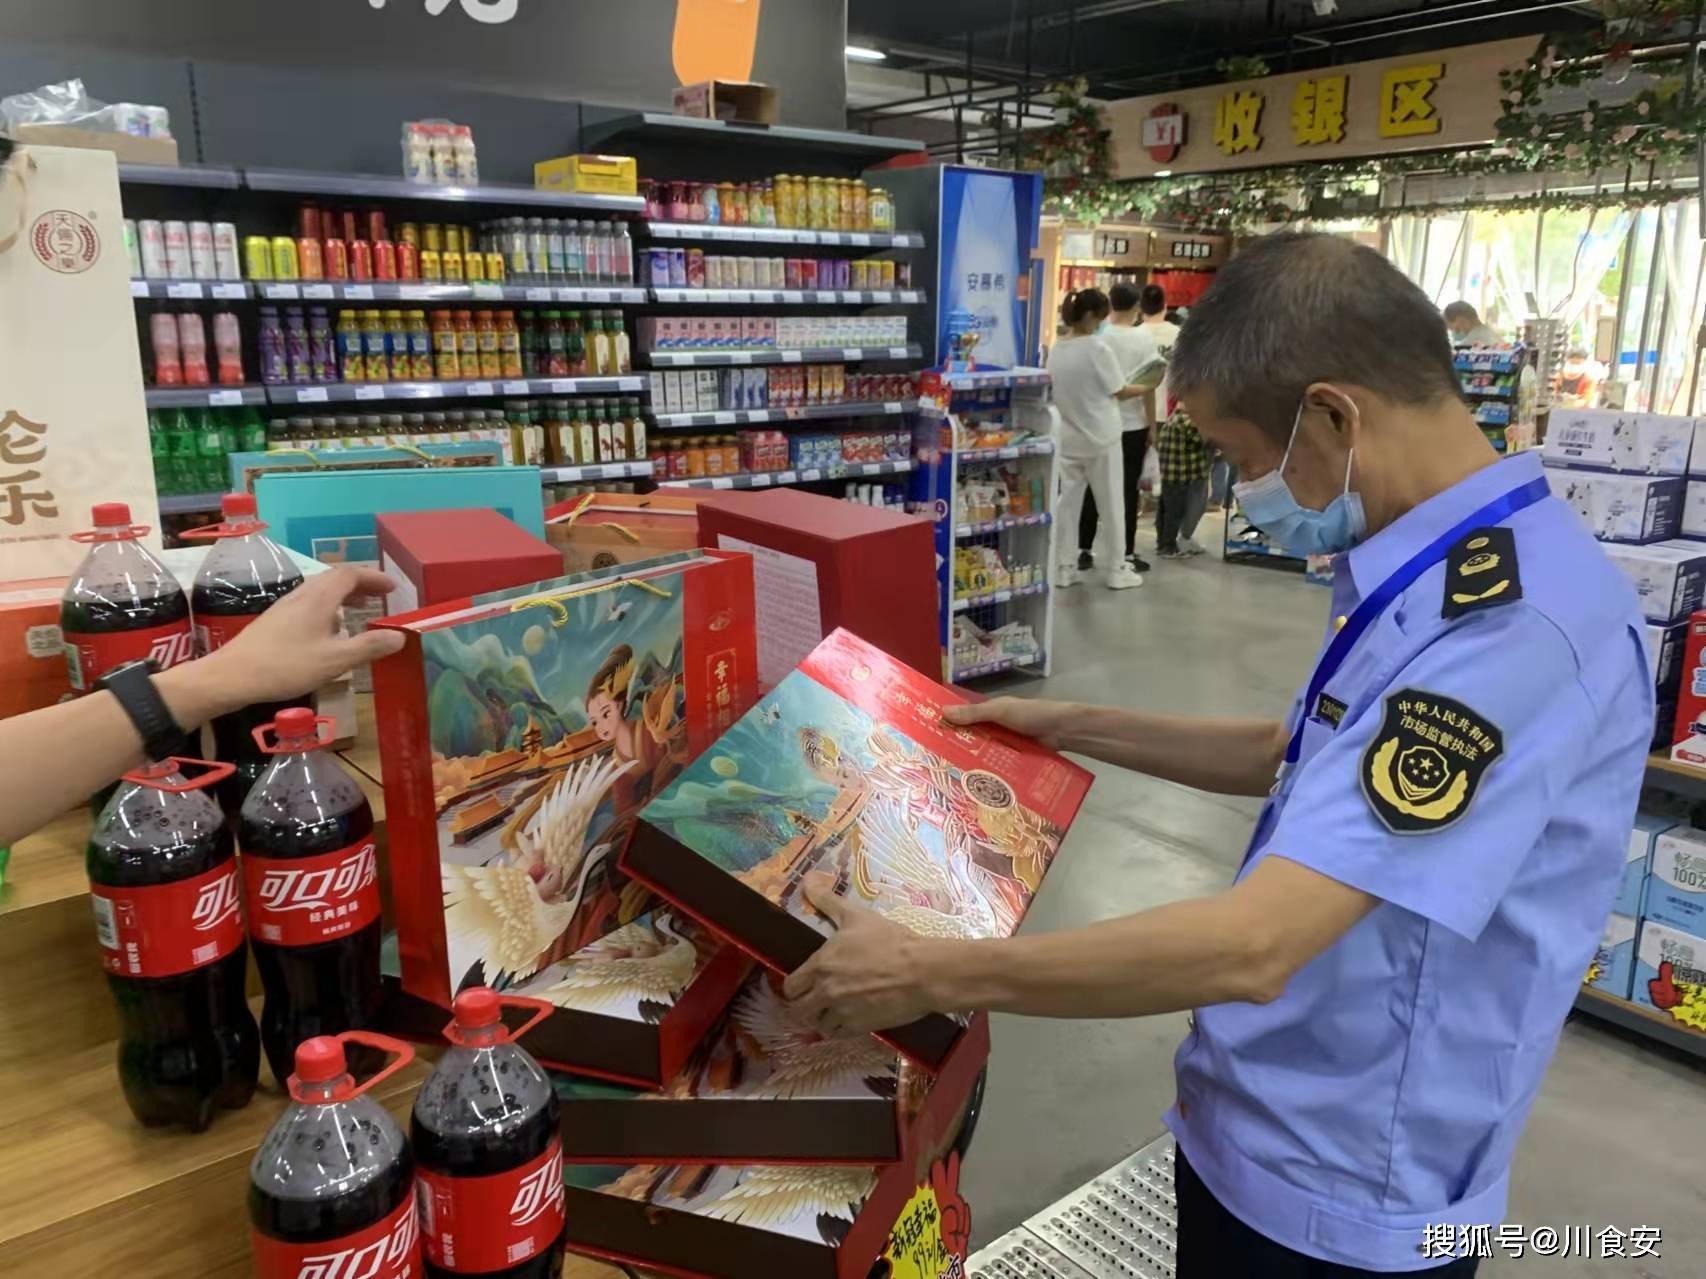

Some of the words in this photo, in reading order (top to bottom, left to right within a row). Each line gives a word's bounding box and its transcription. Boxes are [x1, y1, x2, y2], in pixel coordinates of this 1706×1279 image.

[1214, 63, 1446, 157] 收银区
[1398, 700, 1496, 753] 中华人民共和国
